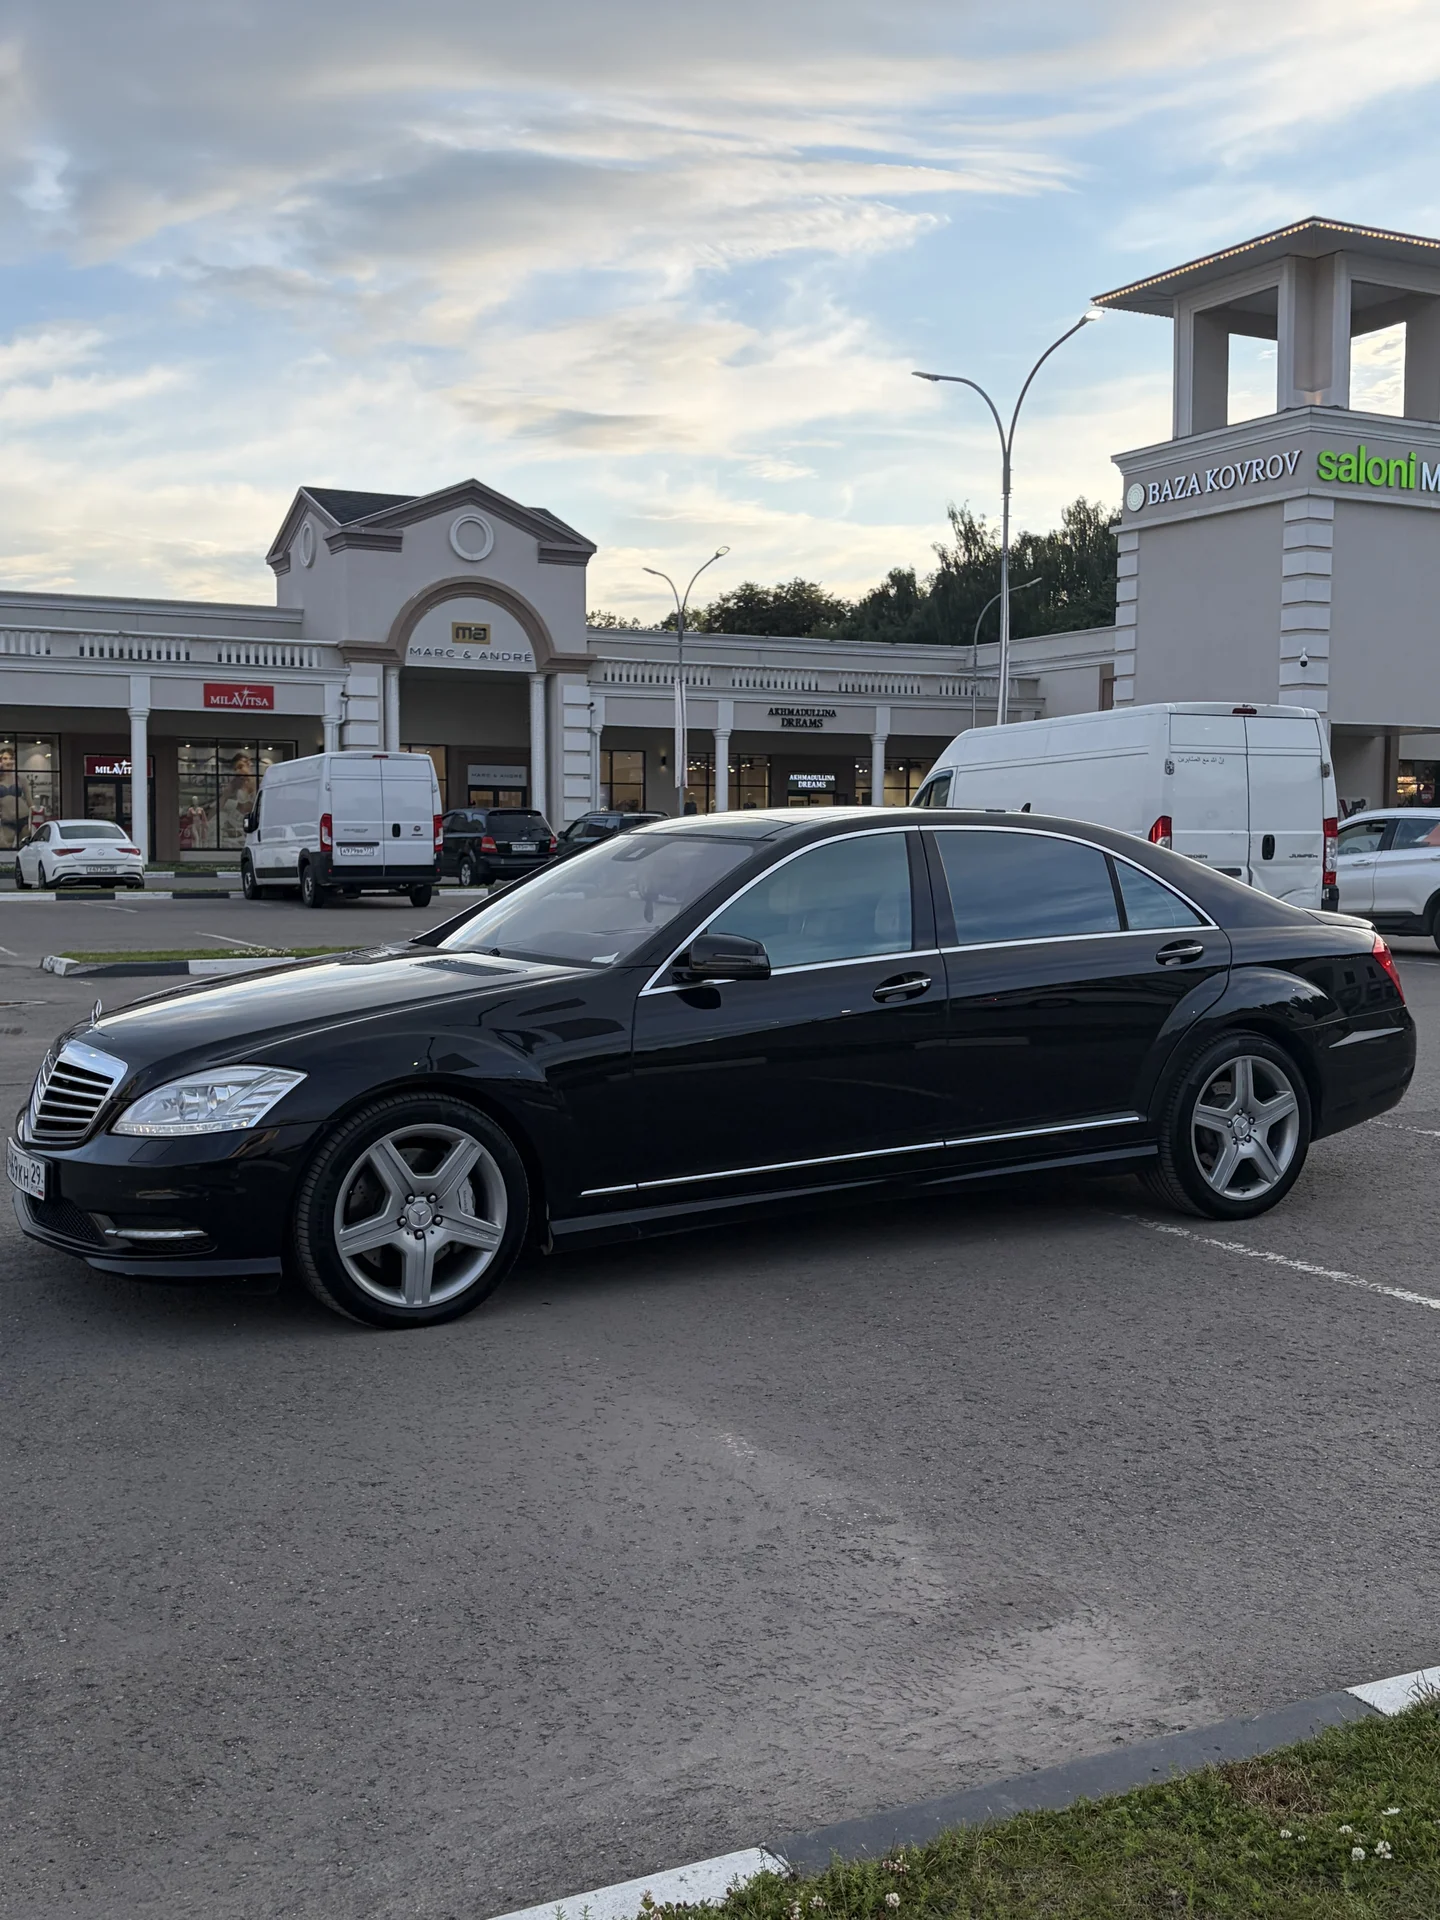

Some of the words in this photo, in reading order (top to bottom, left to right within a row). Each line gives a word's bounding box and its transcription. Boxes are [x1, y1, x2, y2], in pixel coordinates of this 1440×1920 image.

[1317, 444, 1417, 489] saloni
[1147, 473, 1202, 506] BAZA
[1205, 450, 1302, 493] KOVROV
[409, 647, 455, 658] MARC
[462, 650, 472, 659] &
[479, 651, 533, 662] ANDRÉ
[210, 692, 269, 707] MILAVITSA
[767, 707, 837, 718] AKHMADULLINA
[781, 718, 824, 728] DREAMS
[95, 762, 132, 775] MILAVIT
[789, 774, 836, 782] AKHMADULLINA
[797, 781, 827, 789] DREAMS
[31, 1162, 41, 1186] 29
